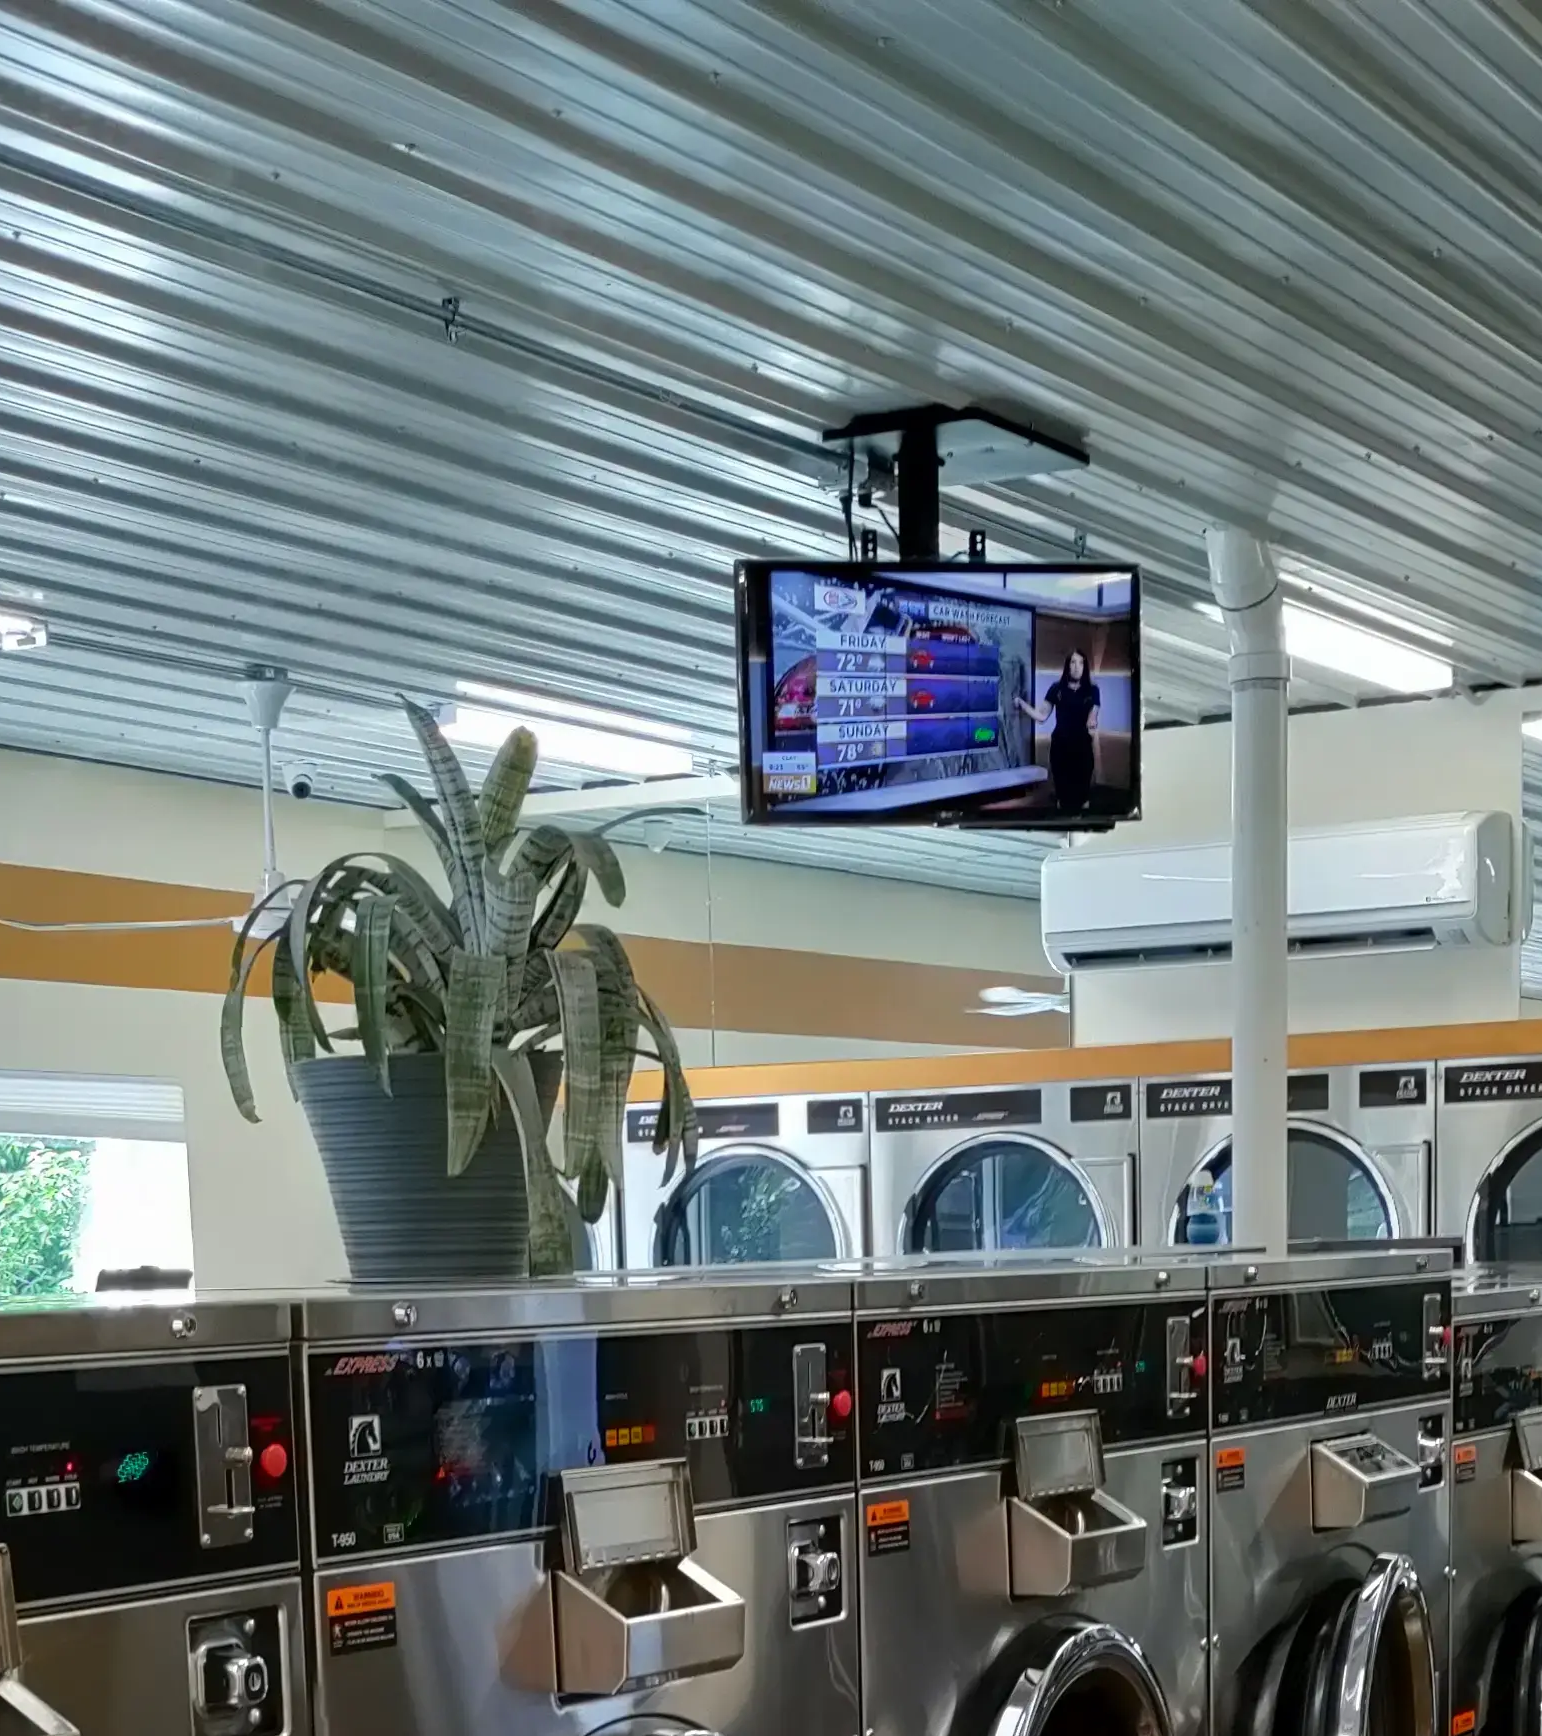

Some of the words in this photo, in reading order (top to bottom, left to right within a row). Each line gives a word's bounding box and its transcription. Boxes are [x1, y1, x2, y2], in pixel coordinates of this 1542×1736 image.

[839, 635, 887, 650] FRIDAY
[829, 680, 897, 693] SATURDAY
[838, 724, 889, 739] SUNDAY
[1459, 1069, 1526, 1083] DEXTER
[1160, 1086, 1221, 1099] DEXTER
[888, 1101, 943, 1113] DEXTER
[1202, 1100, 1230, 1111] DRYE
[334, 1354, 399, 1376] EXPRESS
[416, 1351, 425, 1369] 6
[1326, 1392, 1357, 1410] DEXTER
[344, 1457, 389, 1474] DEXTER
[343, 1470, 390, 1485] LAUNDRY
[331, 1532, 357, 1547] T-950
